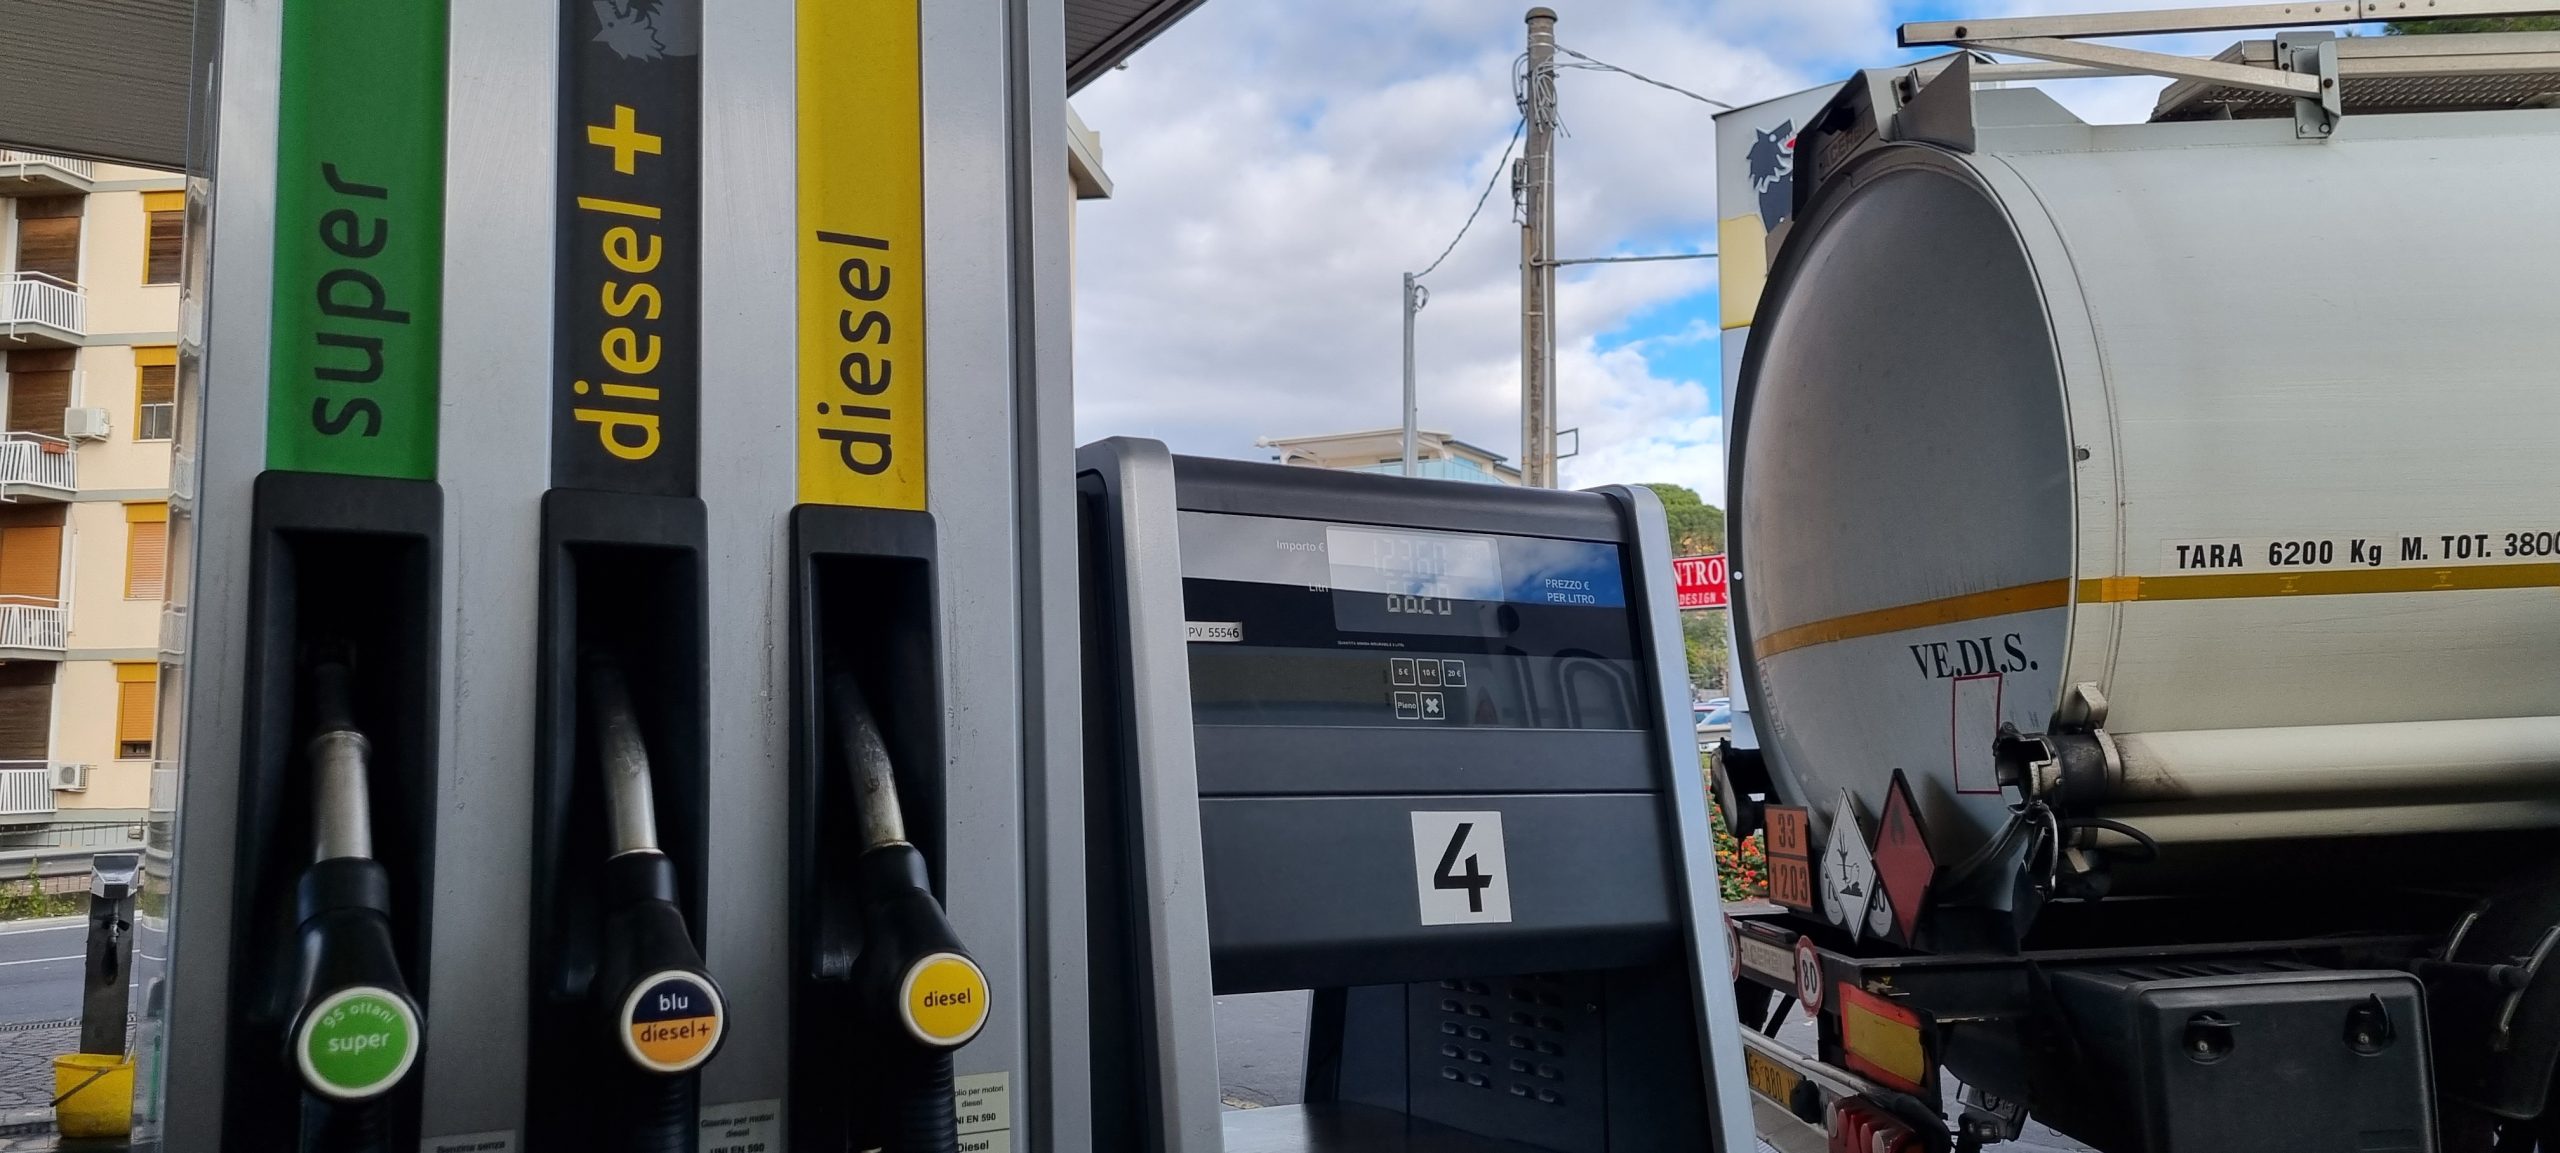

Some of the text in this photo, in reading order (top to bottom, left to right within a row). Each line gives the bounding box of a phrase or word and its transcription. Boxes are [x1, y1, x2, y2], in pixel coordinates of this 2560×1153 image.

[312, 161, 410, 438] super
[816, 230, 892, 476] diesel
[1276, 540, 1326, 552] Importo €
[2176, 543, 2243, 569] TARA
[2268, 540, 2333, 566] 6200
[2350, 539, 2382, 567] Kg
[2401, 536, 2428, 562] M.
[2441, 534, 2492, 560] TOT.
[1545, 579, 1590, 591] PREZZO €
[1547, 592, 1596, 605] PER LITRO
[1679, 591, 1717, 606] DESIGN
[1188, 626, 1240, 639] PV 55546
[1777, 813, 1796, 849] 33
[1433, 822, 1493, 913] 4
[1771, 863, 1809, 905] 1203
[1802, 959, 1818, 994] 80
[659, 992, 689, 1012] blu
[923, 987, 972, 1008] diesel
[322, 1001, 397, 1029] 95 ottani
[328, 1032, 390, 1056] super
[966, 1114, 979, 1124] EN
[957, 1139, 989, 1153] Diesel
